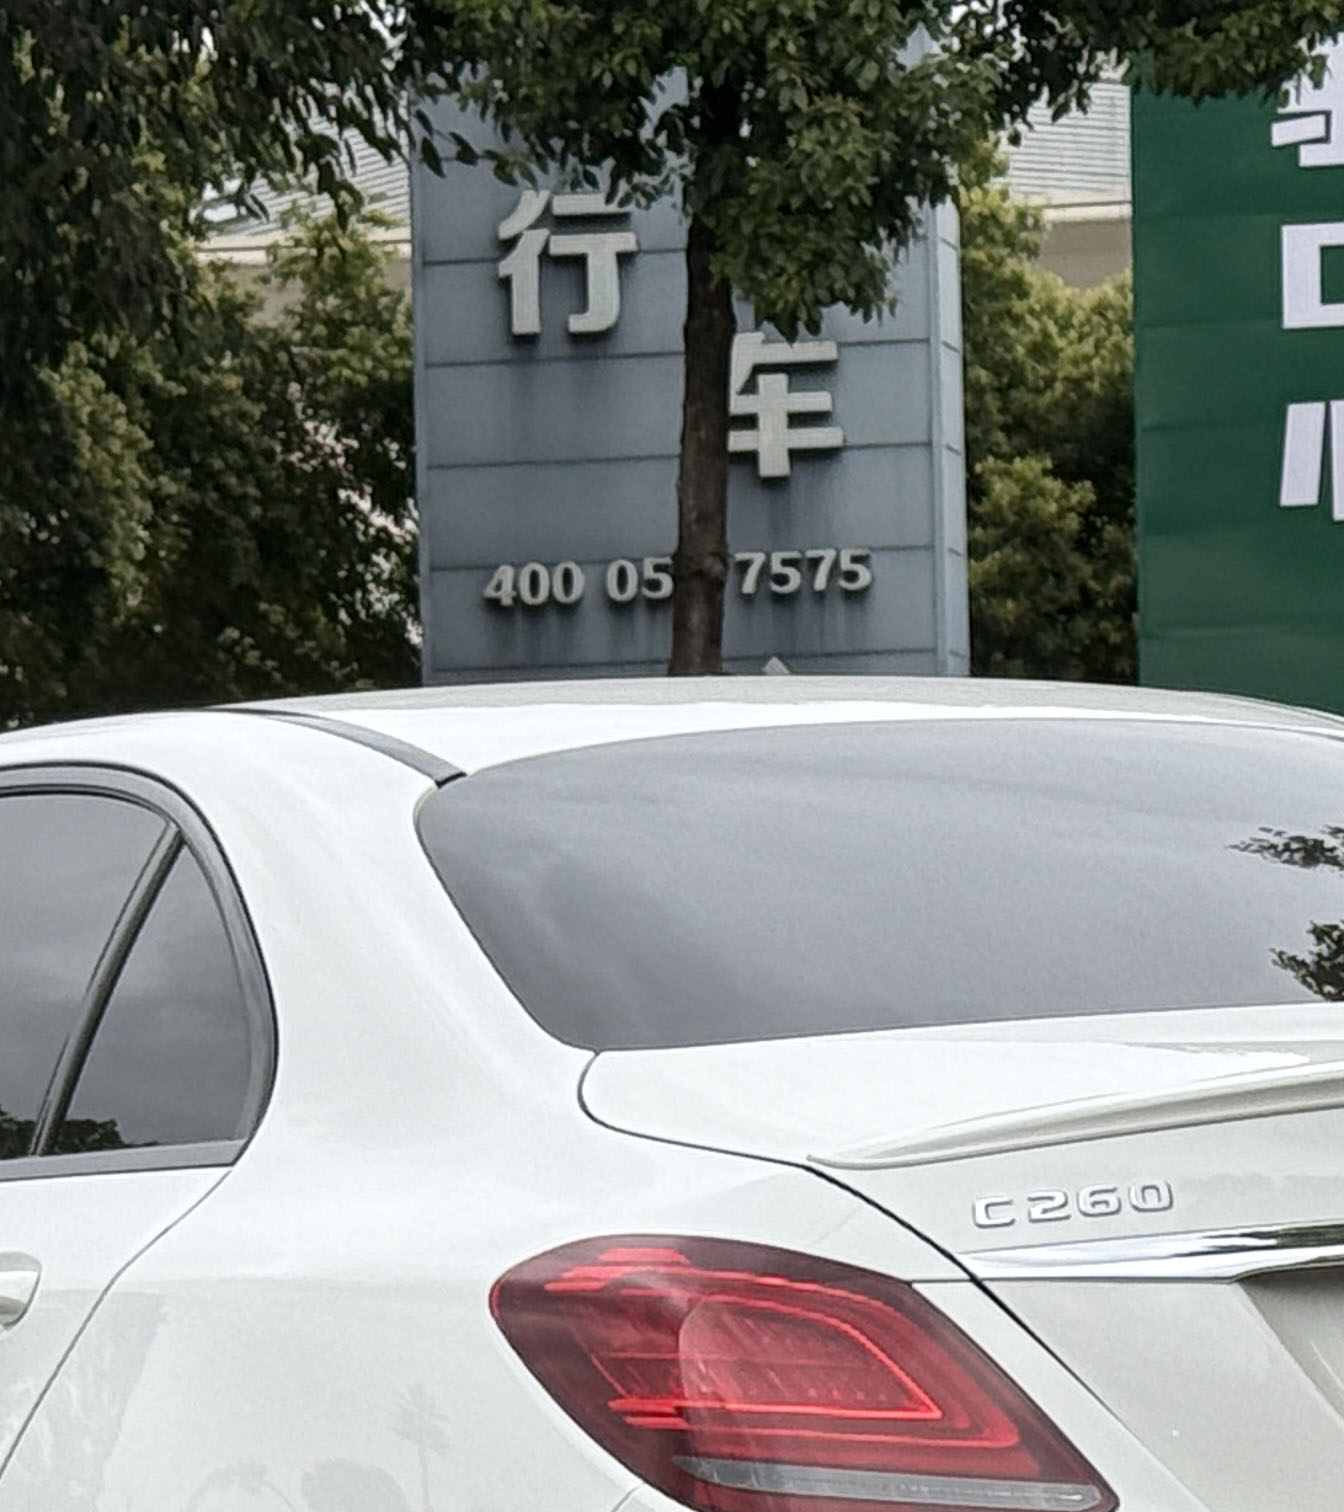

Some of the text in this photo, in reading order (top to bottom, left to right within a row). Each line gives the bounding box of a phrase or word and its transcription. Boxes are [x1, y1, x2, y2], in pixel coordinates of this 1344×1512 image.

[483, 548, 873, 606] 400 05 7575
